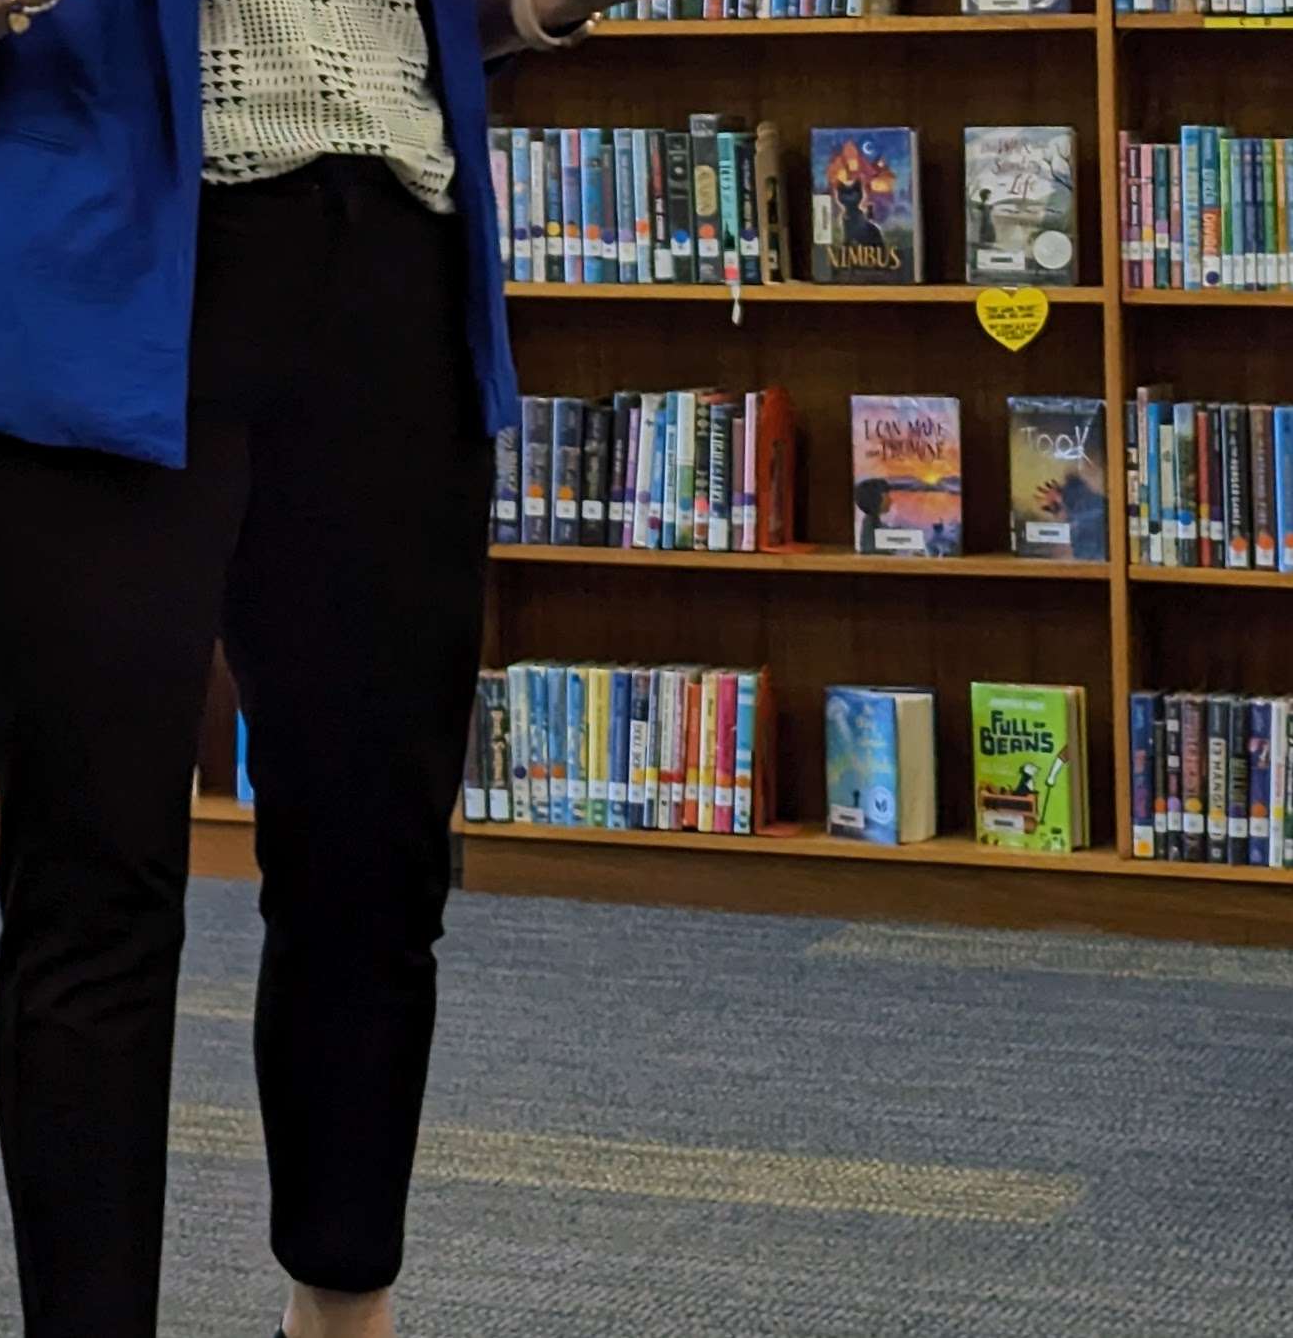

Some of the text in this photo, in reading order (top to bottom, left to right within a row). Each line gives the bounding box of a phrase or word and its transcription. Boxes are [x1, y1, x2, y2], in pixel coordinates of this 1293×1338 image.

[827, 243, 901, 270] NIMBUS
[875, 420, 901, 439] CAN
[991, 710, 1033, 736] FULL
[980, 726, 1054, 756] BEANS
